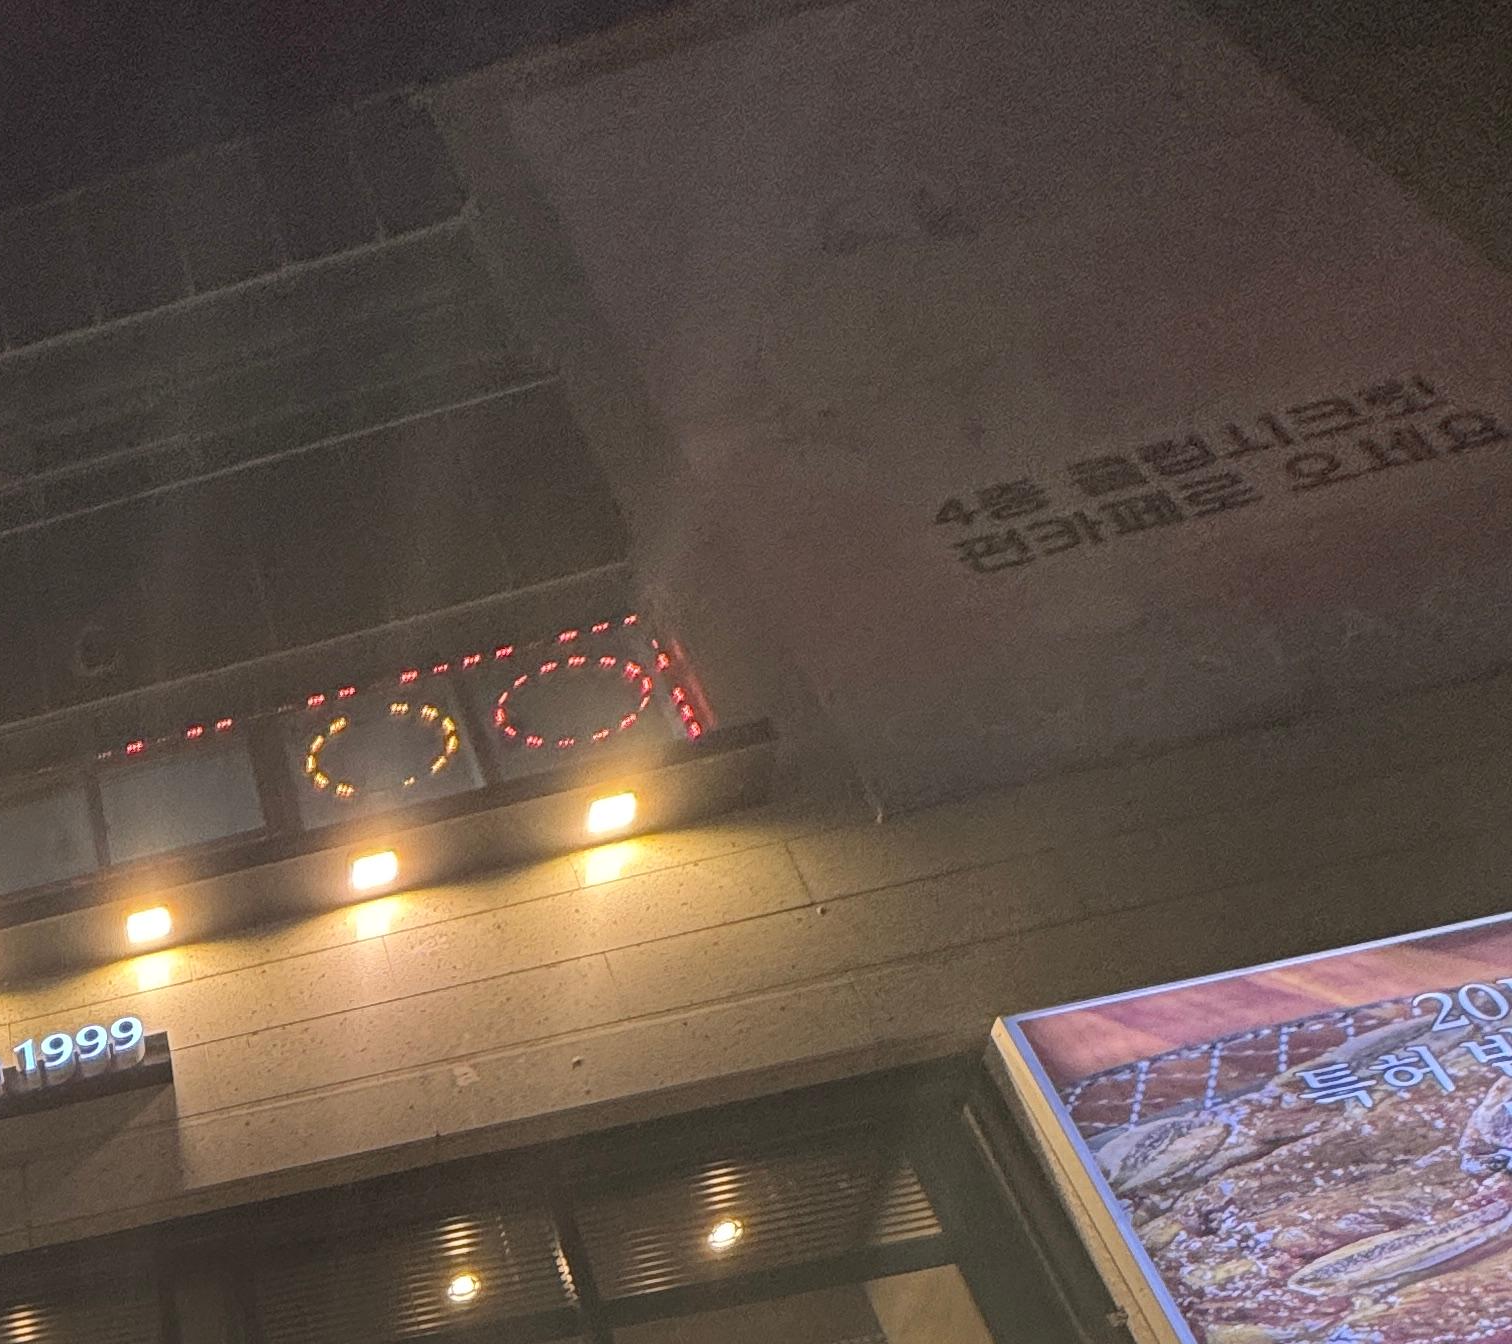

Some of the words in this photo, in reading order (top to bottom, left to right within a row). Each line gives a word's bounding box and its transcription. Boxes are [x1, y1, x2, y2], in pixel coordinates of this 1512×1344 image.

[1411, 977, 1512, 1033] 20
[14, 1015, 146, 1076] 1999
[1296, 1044, 1456, 1109] 특허
